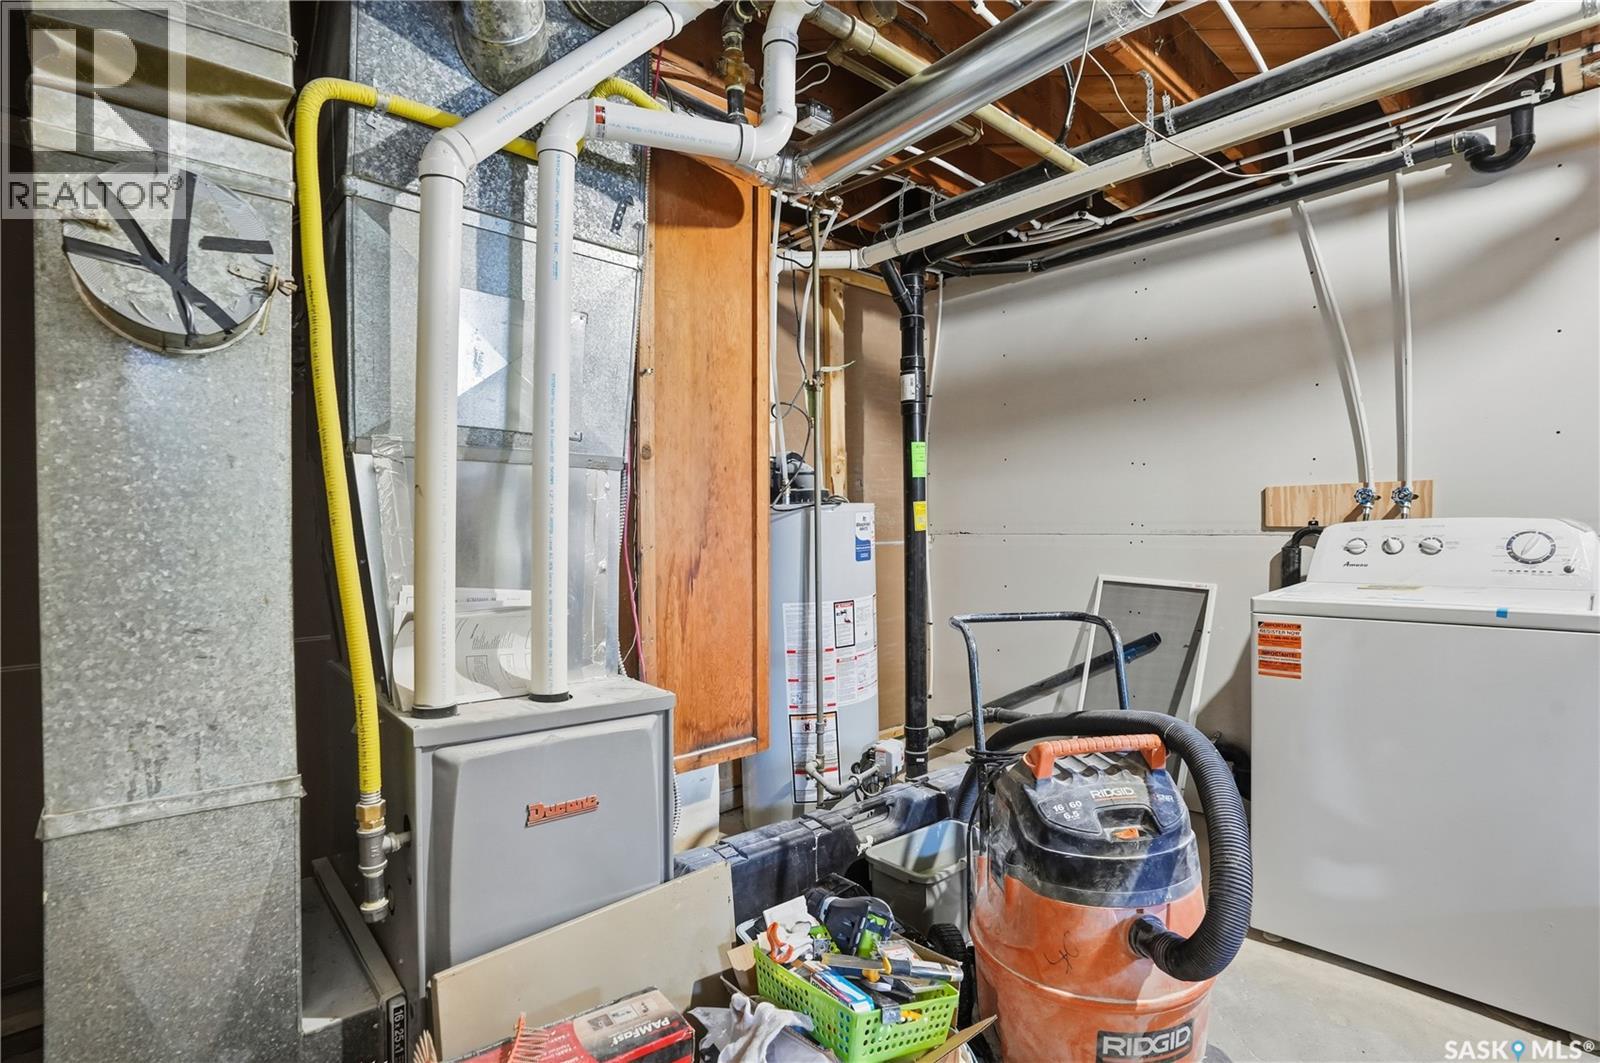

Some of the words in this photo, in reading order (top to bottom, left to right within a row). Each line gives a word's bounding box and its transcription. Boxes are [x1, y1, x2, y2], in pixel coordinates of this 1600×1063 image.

[1090, 786, 1136, 800] RIDGID
[527, 794, 599, 822] Ducane
[1052, 803, 1065, 813] 16
[1068, 800, 1083, 809] 60
[1063, 810, 1080, 820] 6.5
[1102, 1026, 1191, 1056] RIDGID
